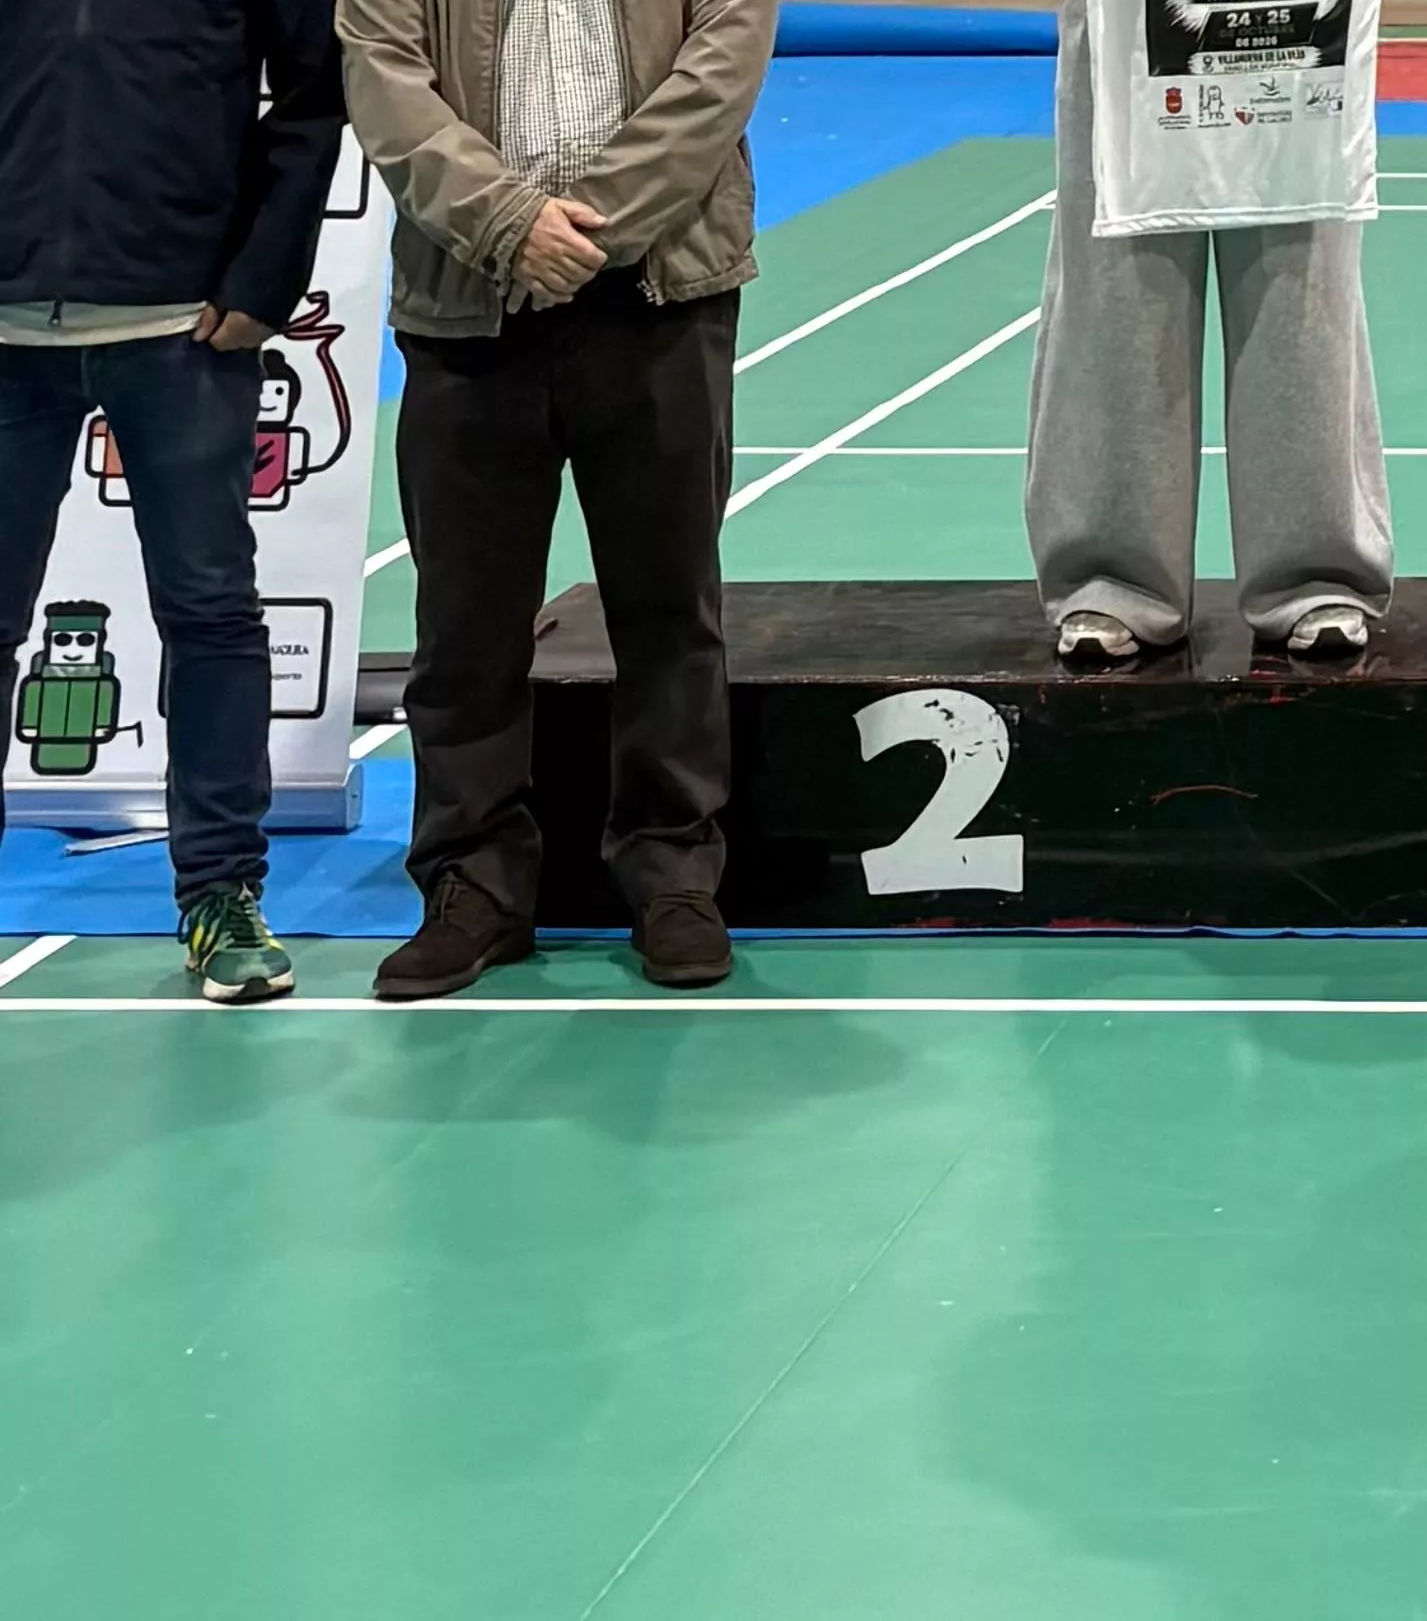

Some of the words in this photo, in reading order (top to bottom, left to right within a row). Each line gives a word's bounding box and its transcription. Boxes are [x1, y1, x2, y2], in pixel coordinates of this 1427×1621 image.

[1227, 13, 1250, 27] 24
[1268, 10, 1291, 24] 25
[857, 689, 1025, 896] 2
